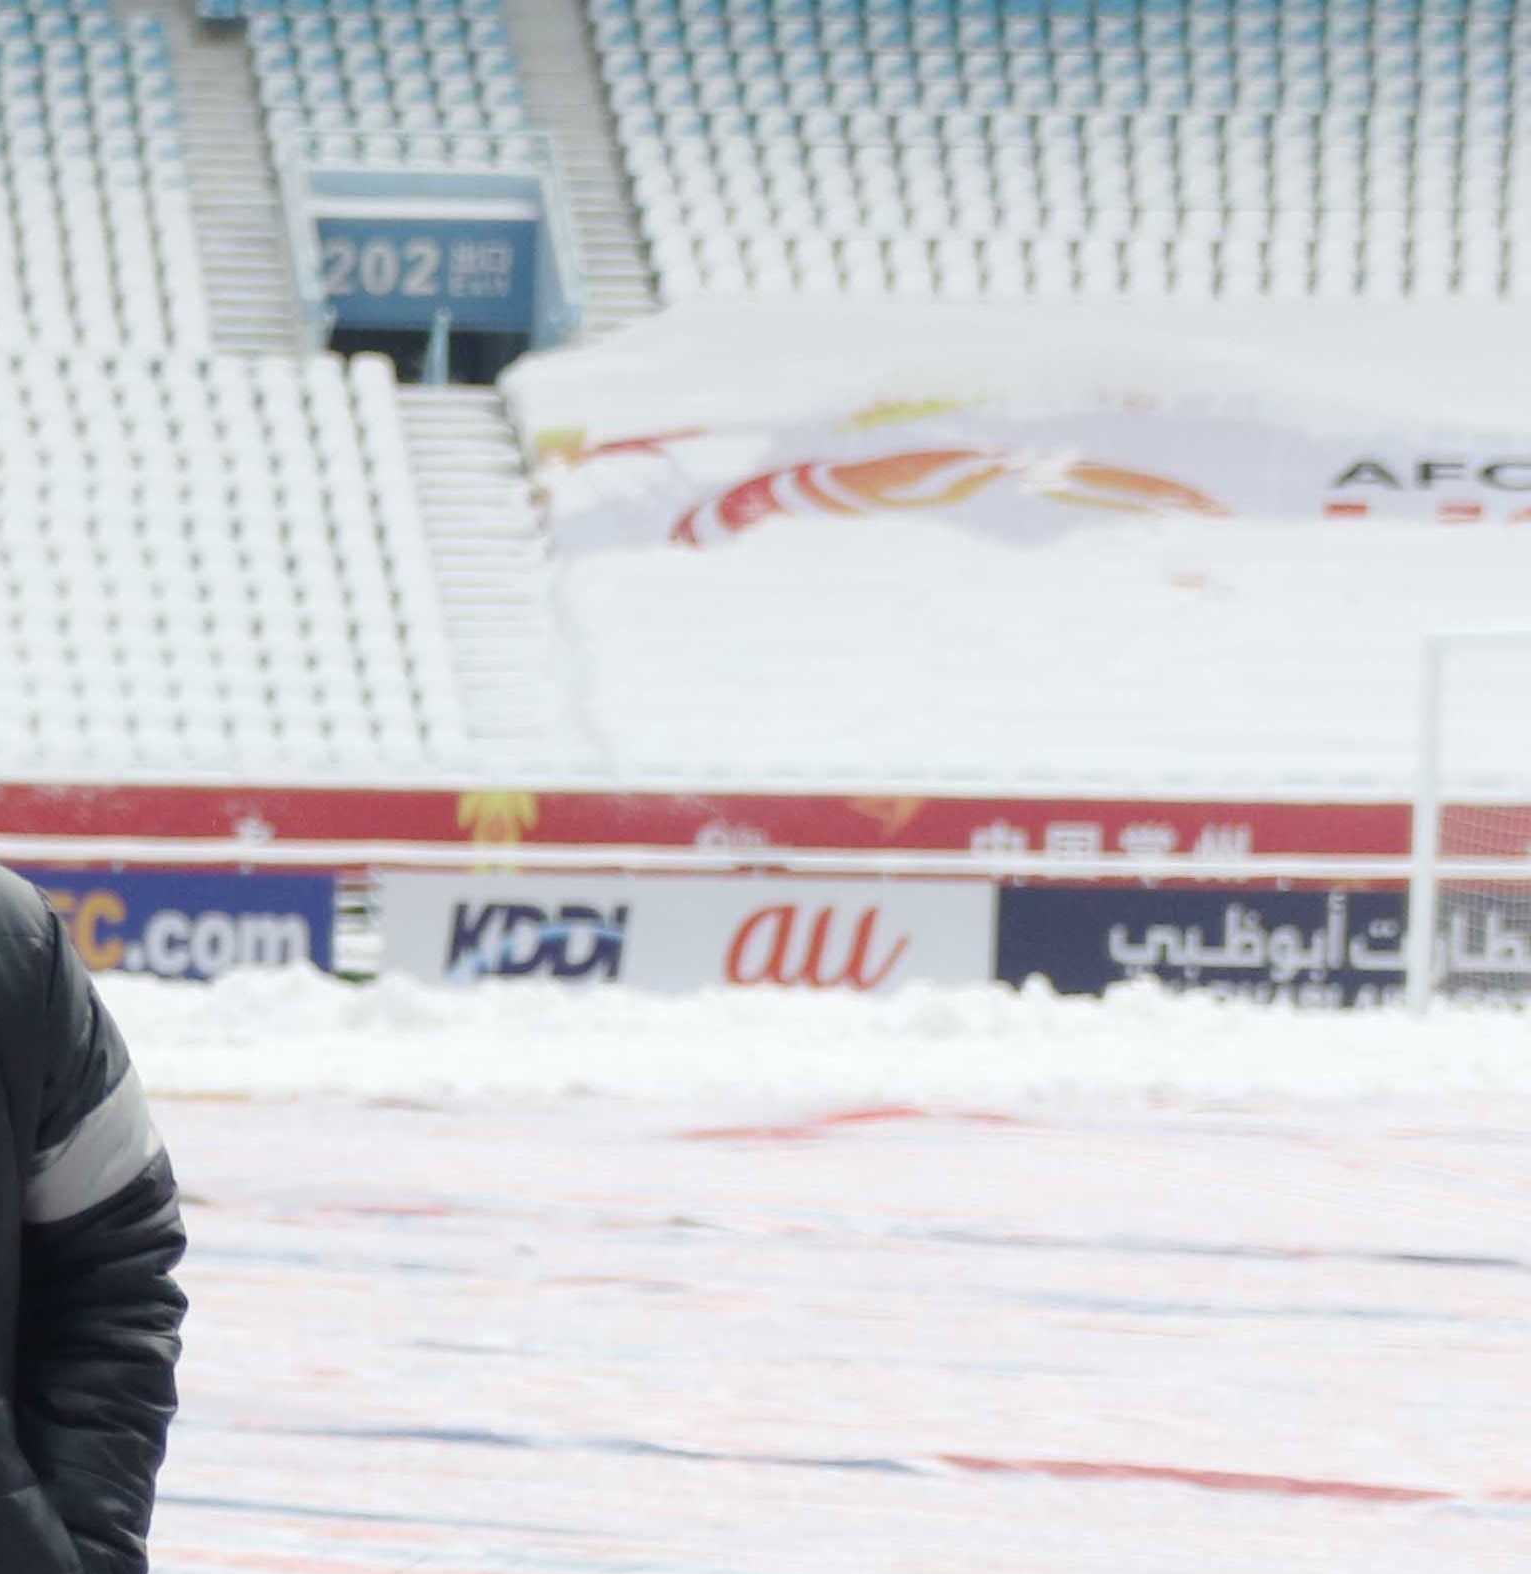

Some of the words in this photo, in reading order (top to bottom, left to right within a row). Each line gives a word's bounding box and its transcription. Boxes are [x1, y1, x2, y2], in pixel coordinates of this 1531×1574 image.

[323, 238, 441, 297] 202
[1329, 458, 1531, 491] AFC
[446, 902, 629, 982] KDDI
[723, 898, 912, 991] au
